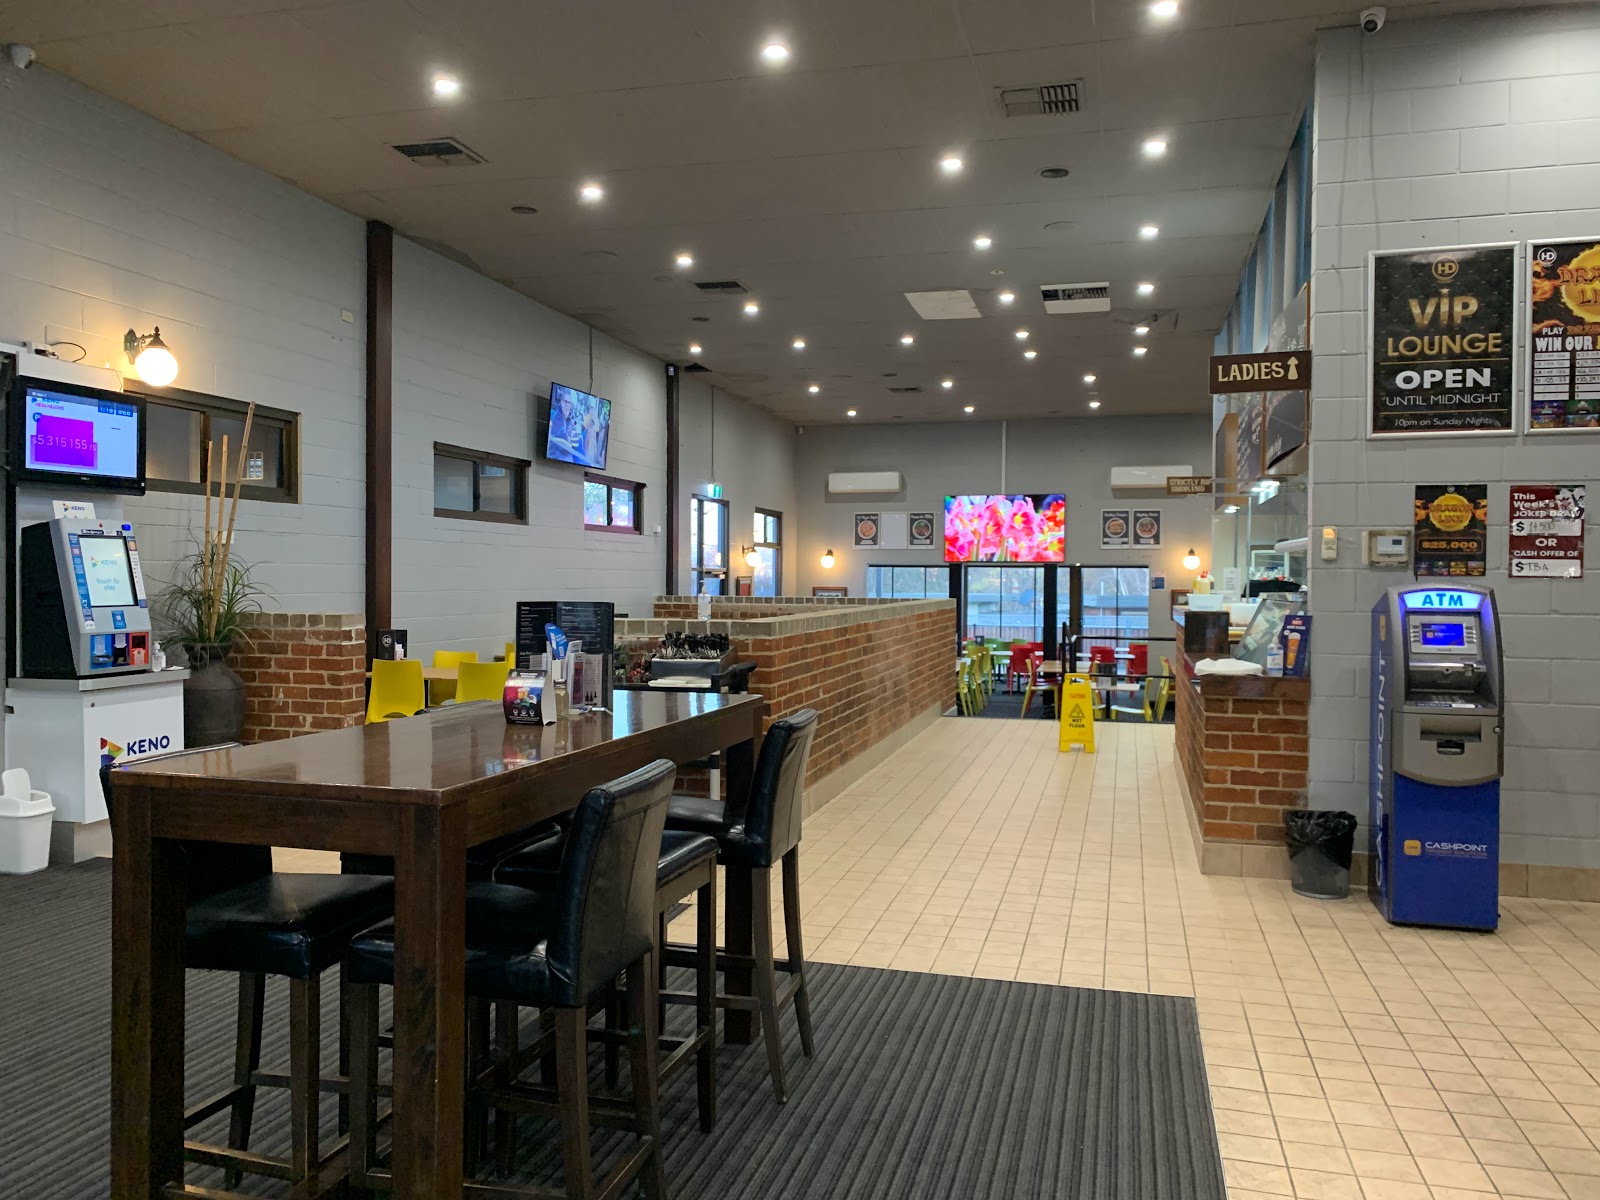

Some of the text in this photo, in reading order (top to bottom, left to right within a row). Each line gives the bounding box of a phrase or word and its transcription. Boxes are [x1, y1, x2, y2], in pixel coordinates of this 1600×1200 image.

[1542, 327, 1564, 335] PLAY
[1387, 333, 1502, 357] LOUNGE
[1535, 336, 1562, 352] WIN
[1565, 335, 1593, 351] OUR
[1218, 362, 1285, 382] LADIES
[1395, 368, 1492, 390] OPEN
[1386, 393, 1502, 406] UNTIL MIDNIGHT
[1395, 418, 1418, 427] 10pm
[1433, 417, 1464, 426] Sunday
[1465, 417, 1493, 426] Nights
[1169, 478, 1199, 486] STRICTLY
[1513, 500, 1555, 508] Week's
[1422, 541, 1478, 549] $25,000
[1535, 538, 1558, 547] OR
[1422, 593, 1463, 607] ATM
[127, 735, 170, 756] KENO
[1375, 650, 1386, 887] CASHPOINT
[1424, 841, 1488, 852] CASHPOINT
